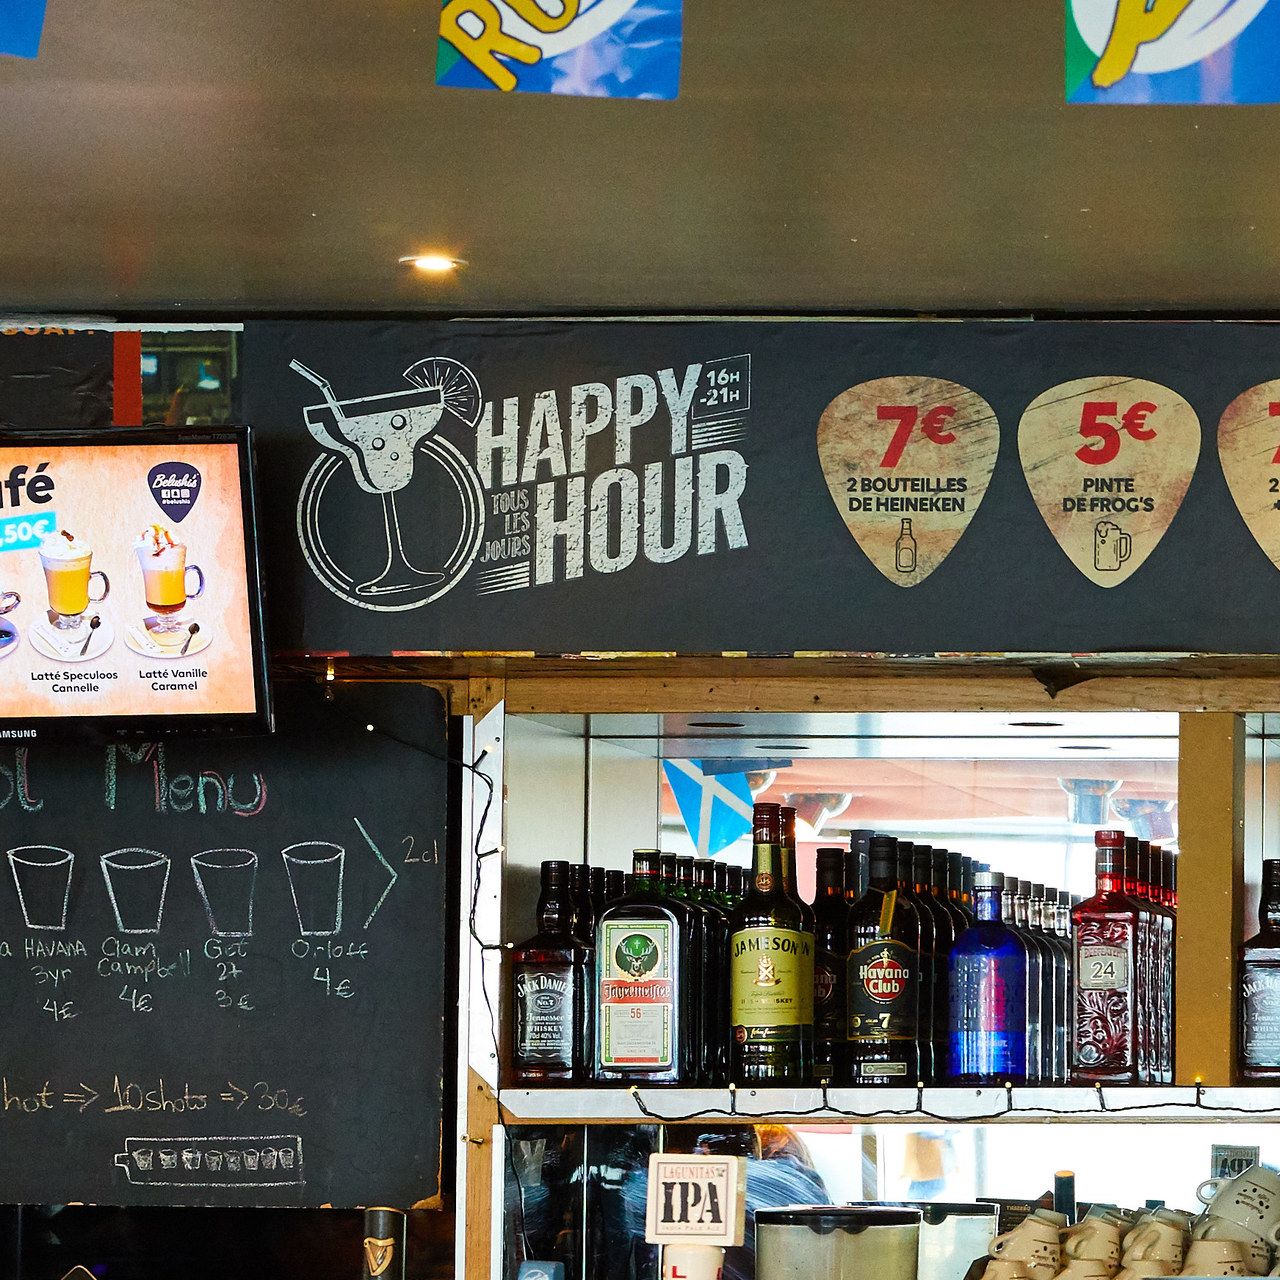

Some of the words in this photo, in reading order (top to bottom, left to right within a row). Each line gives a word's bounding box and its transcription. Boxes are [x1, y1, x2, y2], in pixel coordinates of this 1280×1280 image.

[706, 368, 740, 386] 16H
[475, 363, 703, 489] HAPPY
[1074, 401, 1157, 466] 5€
[876, 405, 956, 468] 7€
[152, 473, 198, 489] Belushi's
[847, 478, 858, 493] 2
[861, 477, 968, 493] BOUTEILLES
[1083, 477, 1135, 493] PINTE
[1269, 478, 1279, 493] 2
[491, 488, 530, 516] TOUS
[848, 496, 873, 512] DE
[876, 496, 966, 513] HEINEKEN
[1062, 496, 1088, 512] DE
[1090, 496, 1155, 513] FROG'S
[504, 512, 531, 536] LES
[535, 448, 748, 587] HOUR
[480, 536, 531, 564] JOURS
[31, 669, 60, 681] Latté
[62, 668, 118, 685] Speculoos
[139, 669, 168, 681] Latté
[169, 669, 208, 680] Vanille
[52, 682, 99, 694] Cannelle
[151, 681, 198, 692] Caramel
[105, 743, 267, 817] Menu
[734, 937, 798, 958] JAMESON
[859, 965, 909, 980] Havana
[1091, 961, 1116, 979] 24
[869, 980, 900, 994] Club
[630, 1007, 642, 1019] 56
[878, 1013, 891, 1029] 7
[663, 1166, 716, 1179] LAGUNITAS
[661, 1182, 723, 1223] IPA
